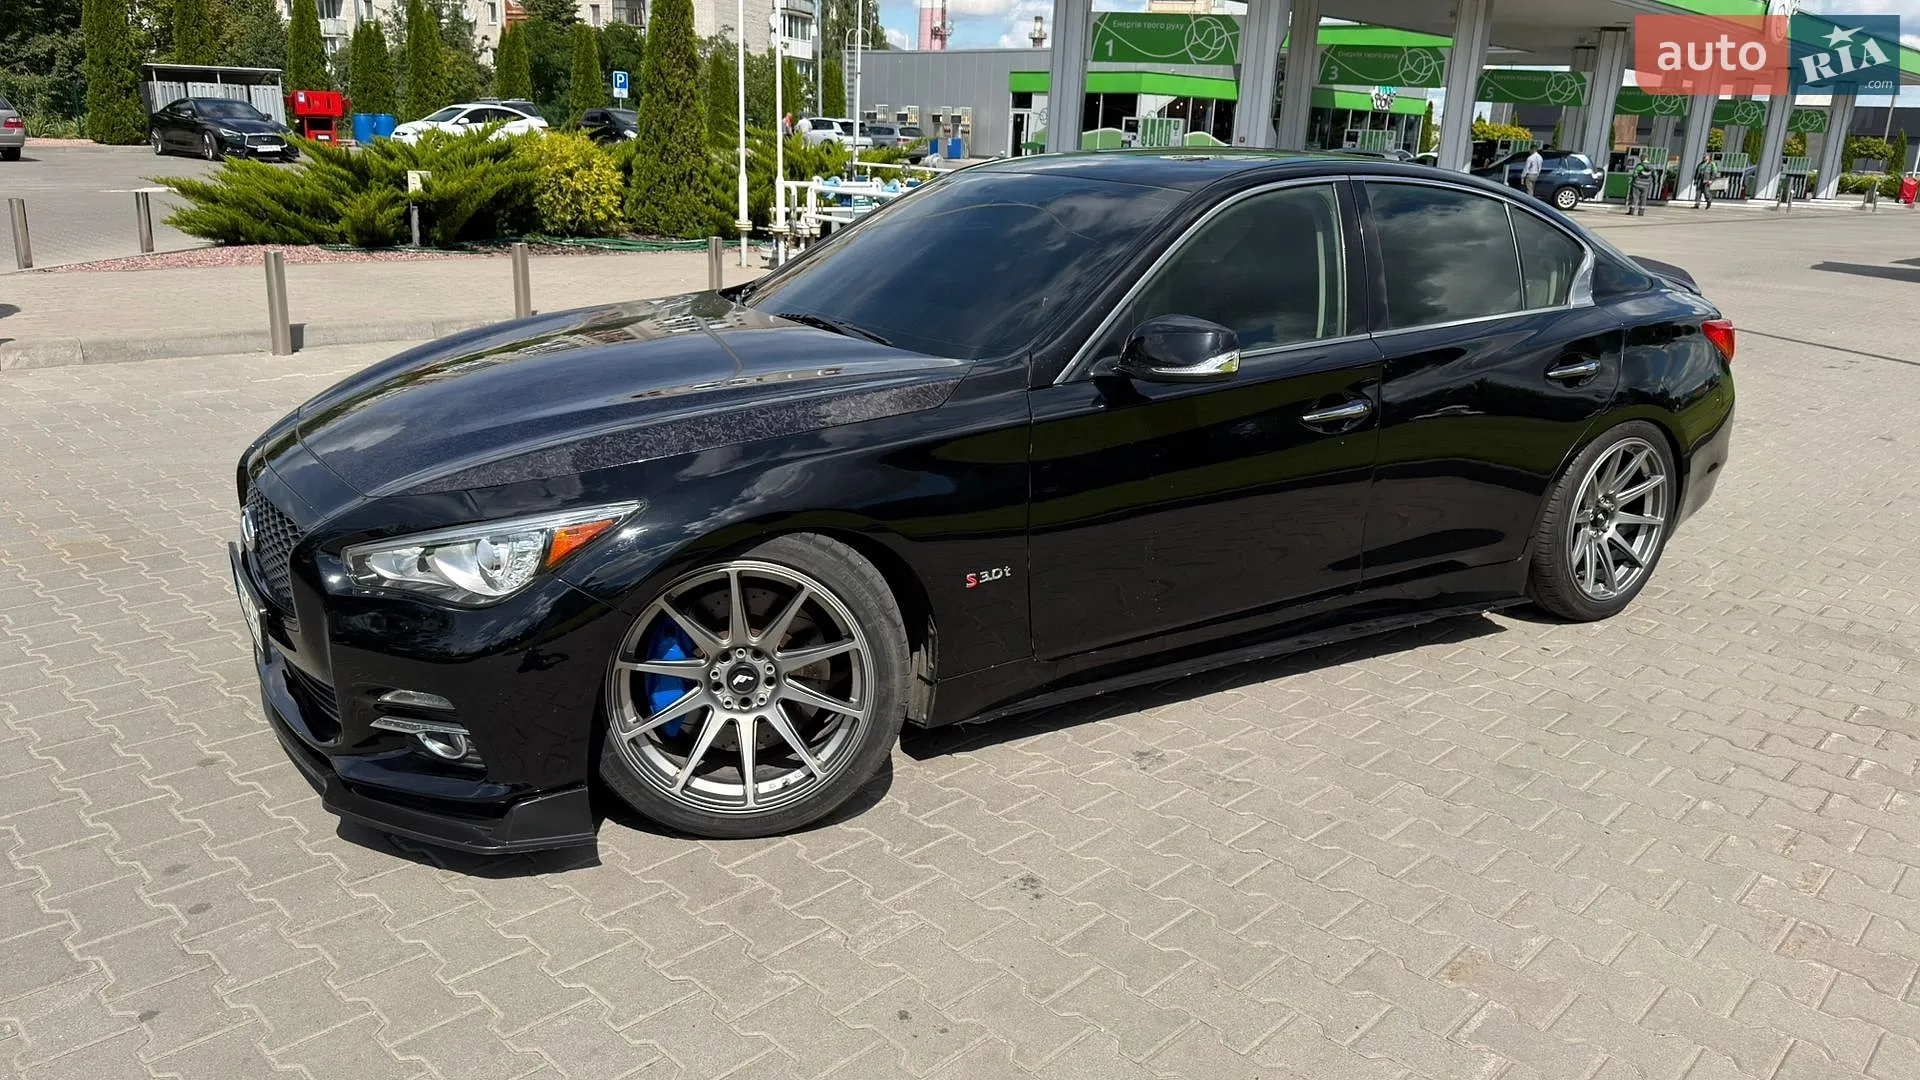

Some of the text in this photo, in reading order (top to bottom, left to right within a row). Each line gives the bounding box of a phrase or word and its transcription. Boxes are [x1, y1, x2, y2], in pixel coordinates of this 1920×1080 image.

[1105, 39, 1114, 57] 1
[616, 73, 625, 87] P
[1328, 65, 1339, 81] 3
[1485, 87, 1494, 99] 5
[965, 572, 978, 589] S
